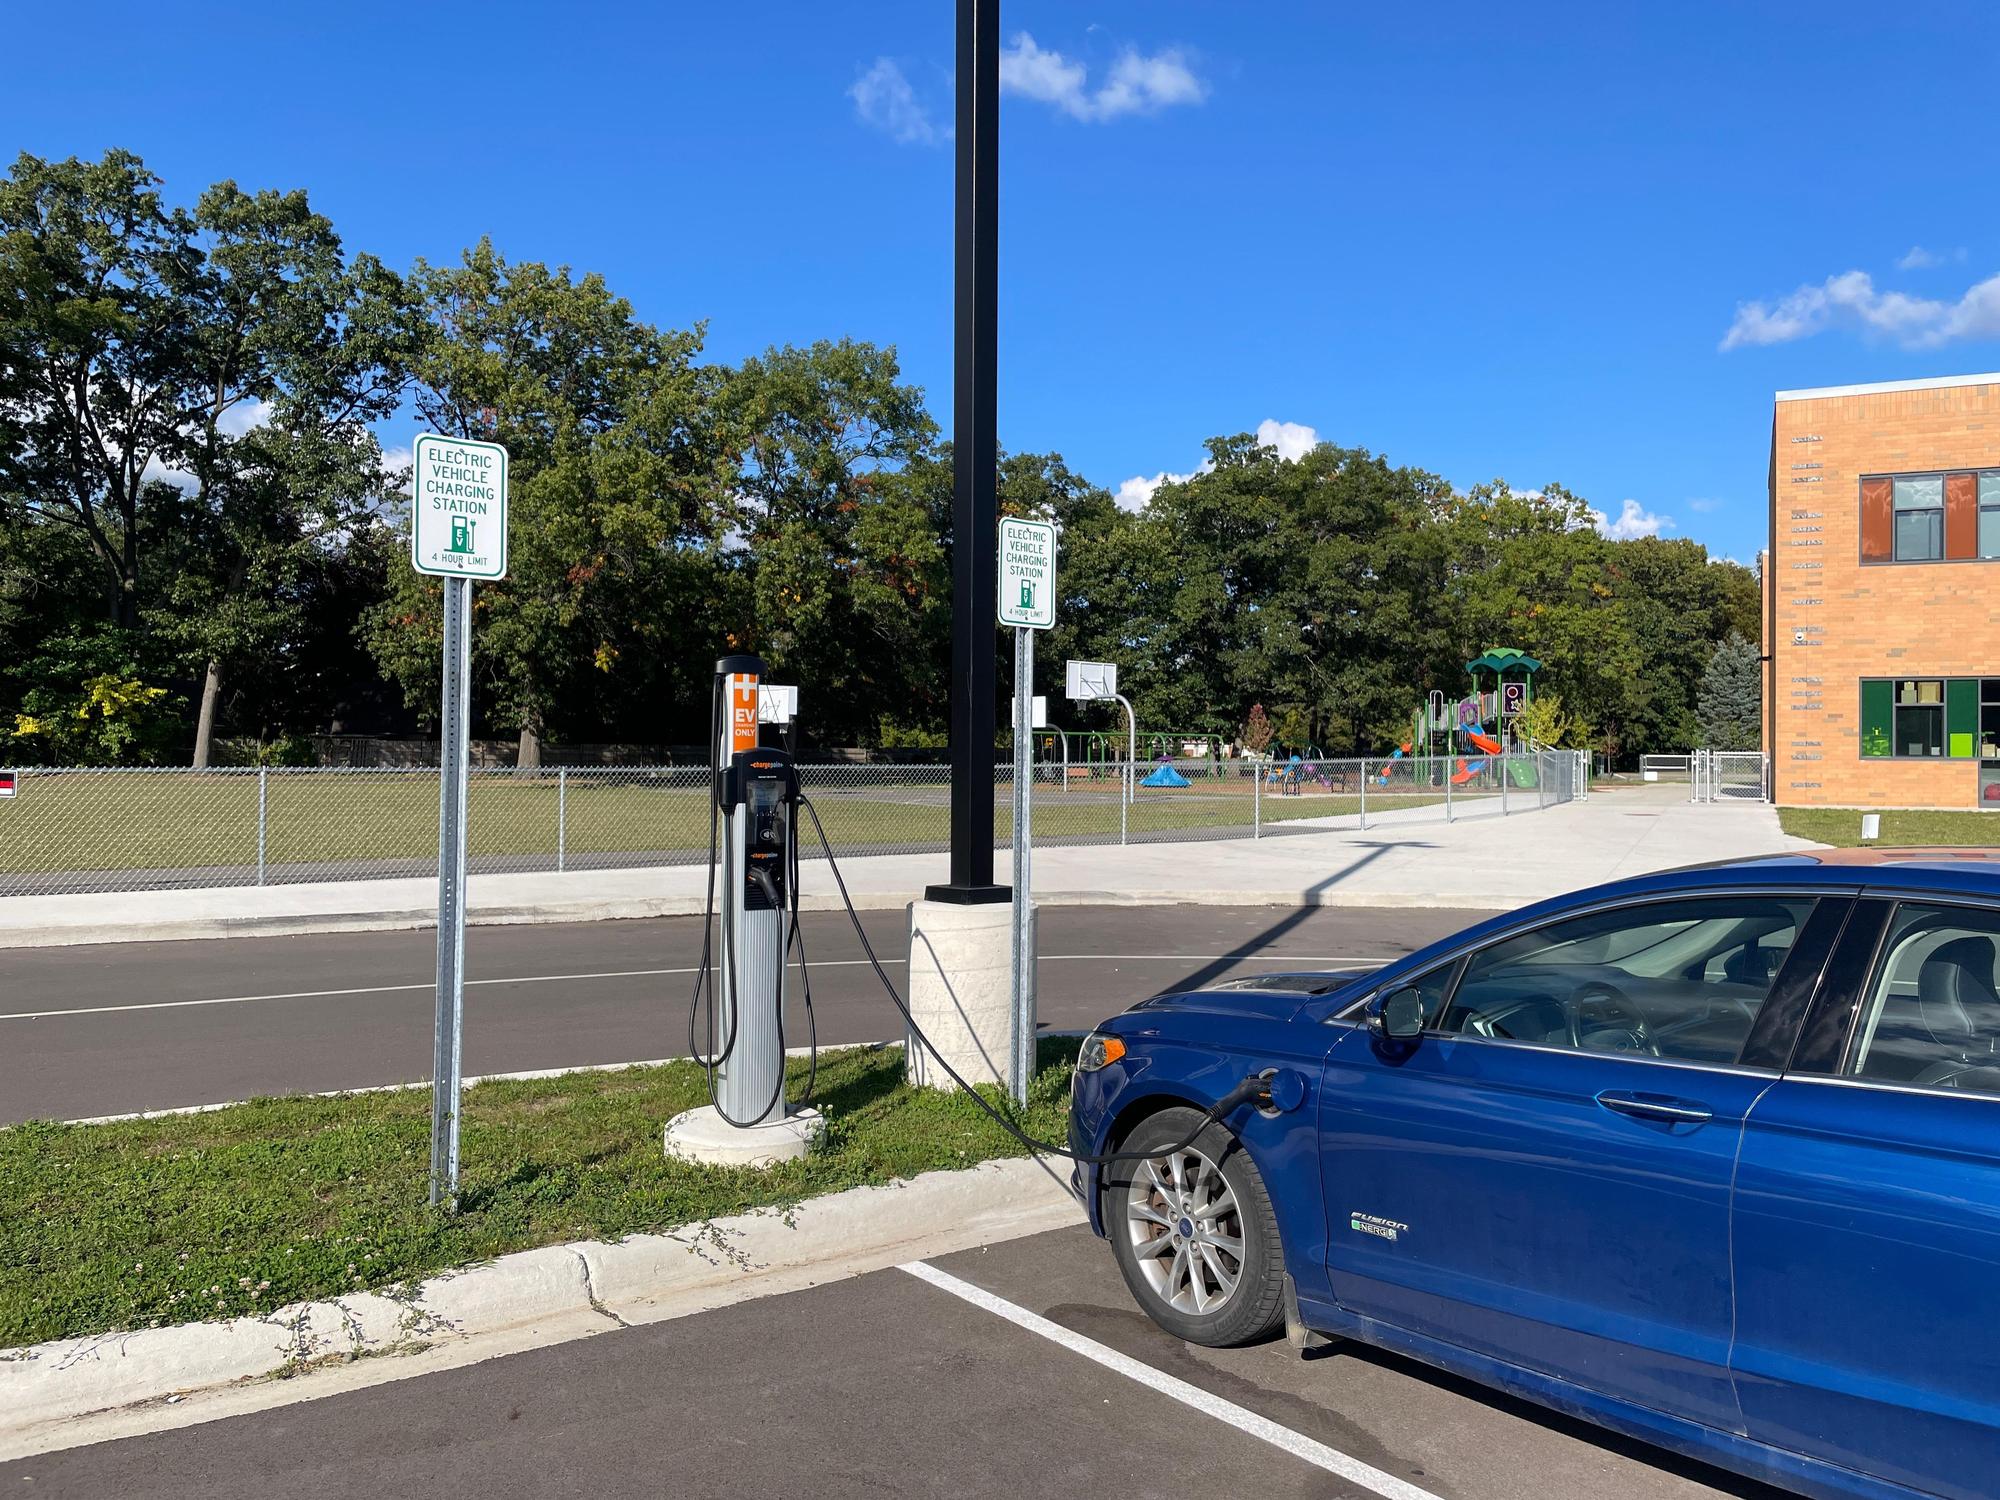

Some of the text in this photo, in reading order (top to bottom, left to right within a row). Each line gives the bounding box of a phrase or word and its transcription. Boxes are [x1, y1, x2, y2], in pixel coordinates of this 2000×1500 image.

[429, 448, 492, 469] ELECTRIC
[432, 465, 488, 484] VEHICLE
[426, 480, 494, 500] CHARGING
[433, 497, 487, 515] STATION
[1007, 528, 1046, 542] ELECTRIC
[1010, 541, 1043, 554] VEHICLE
[432, 553, 488, 566] 4 HOUR LIMIT
[1006, 553, 1047, 567] CHARGING
[1010, 566, 1043, 578] STATION
[735, 708, 755, 722] EV
[1351, 1211, 1408, 1231] FUSION
